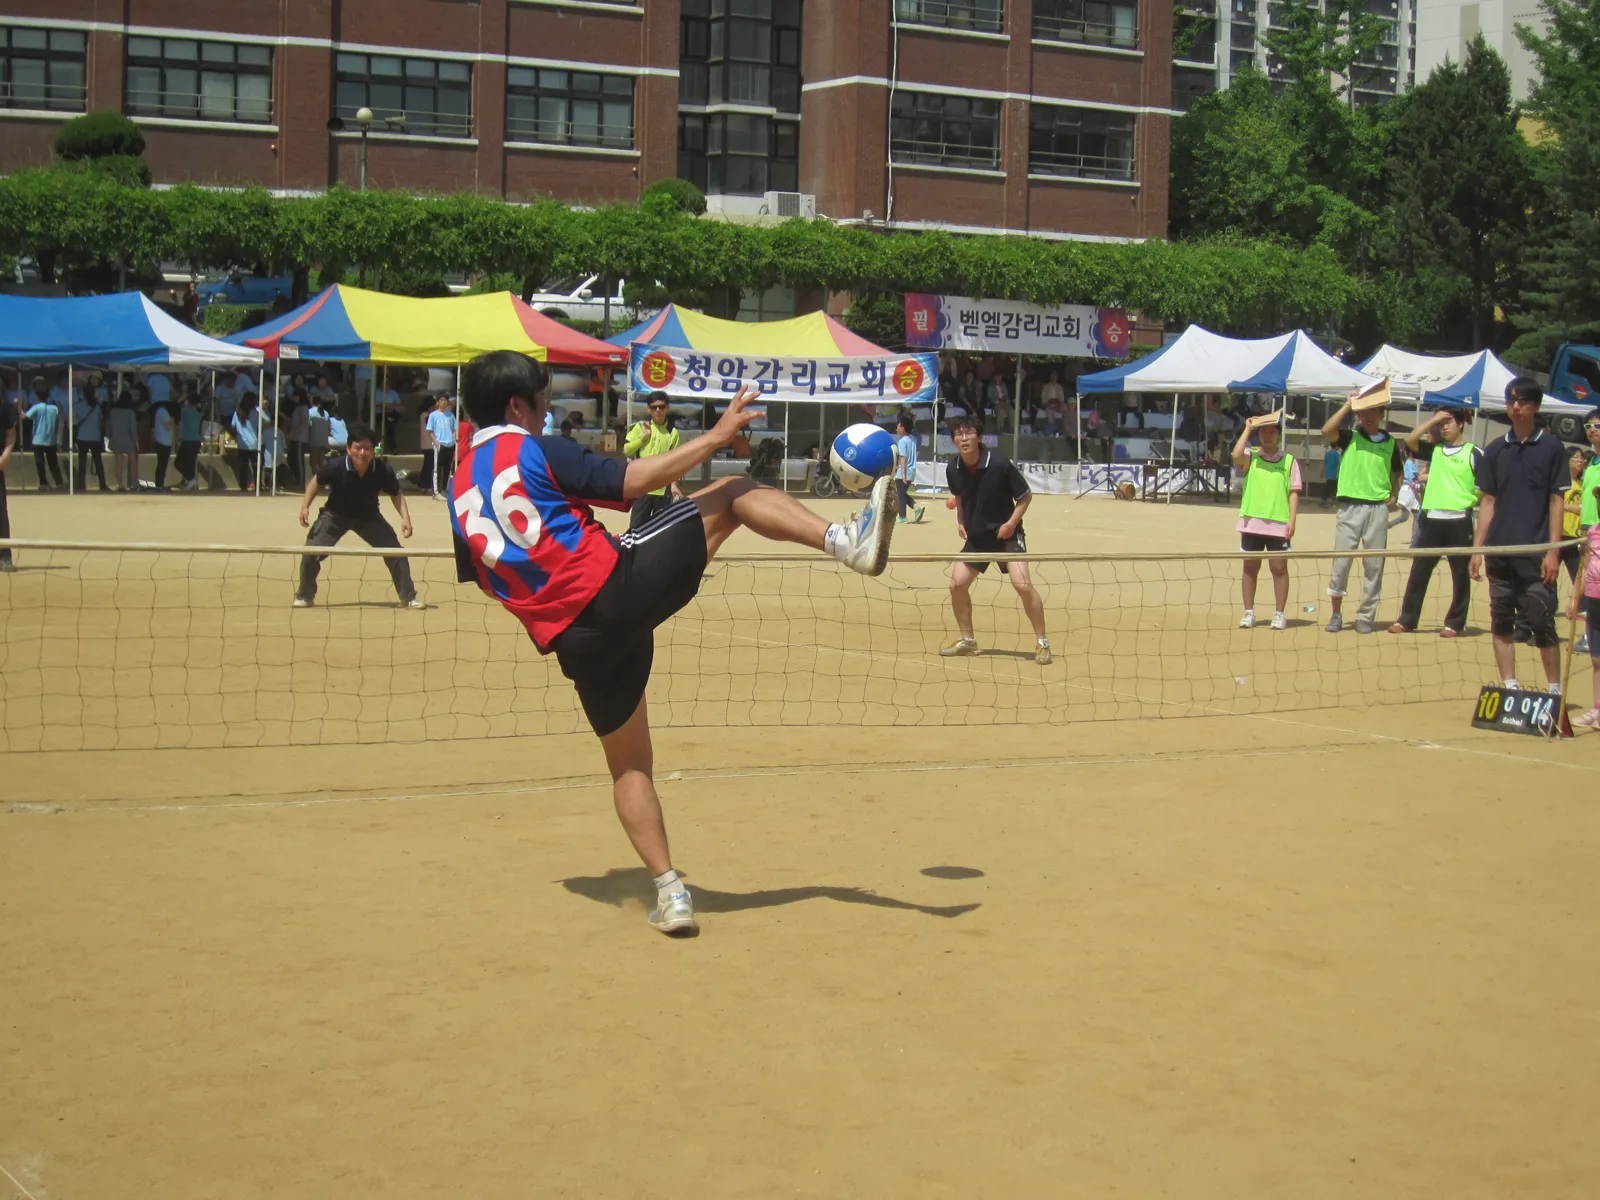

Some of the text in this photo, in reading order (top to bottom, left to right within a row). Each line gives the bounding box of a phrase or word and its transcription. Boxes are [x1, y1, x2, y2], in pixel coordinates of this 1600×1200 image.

[912, 309, 1123, 344] 필 벧엘감리교회 승
[649, 354, 926, 396] 필 청암감리교회 승
[453, 464, 542, 569] 36
[1478, 691, 1500, 720] 10
